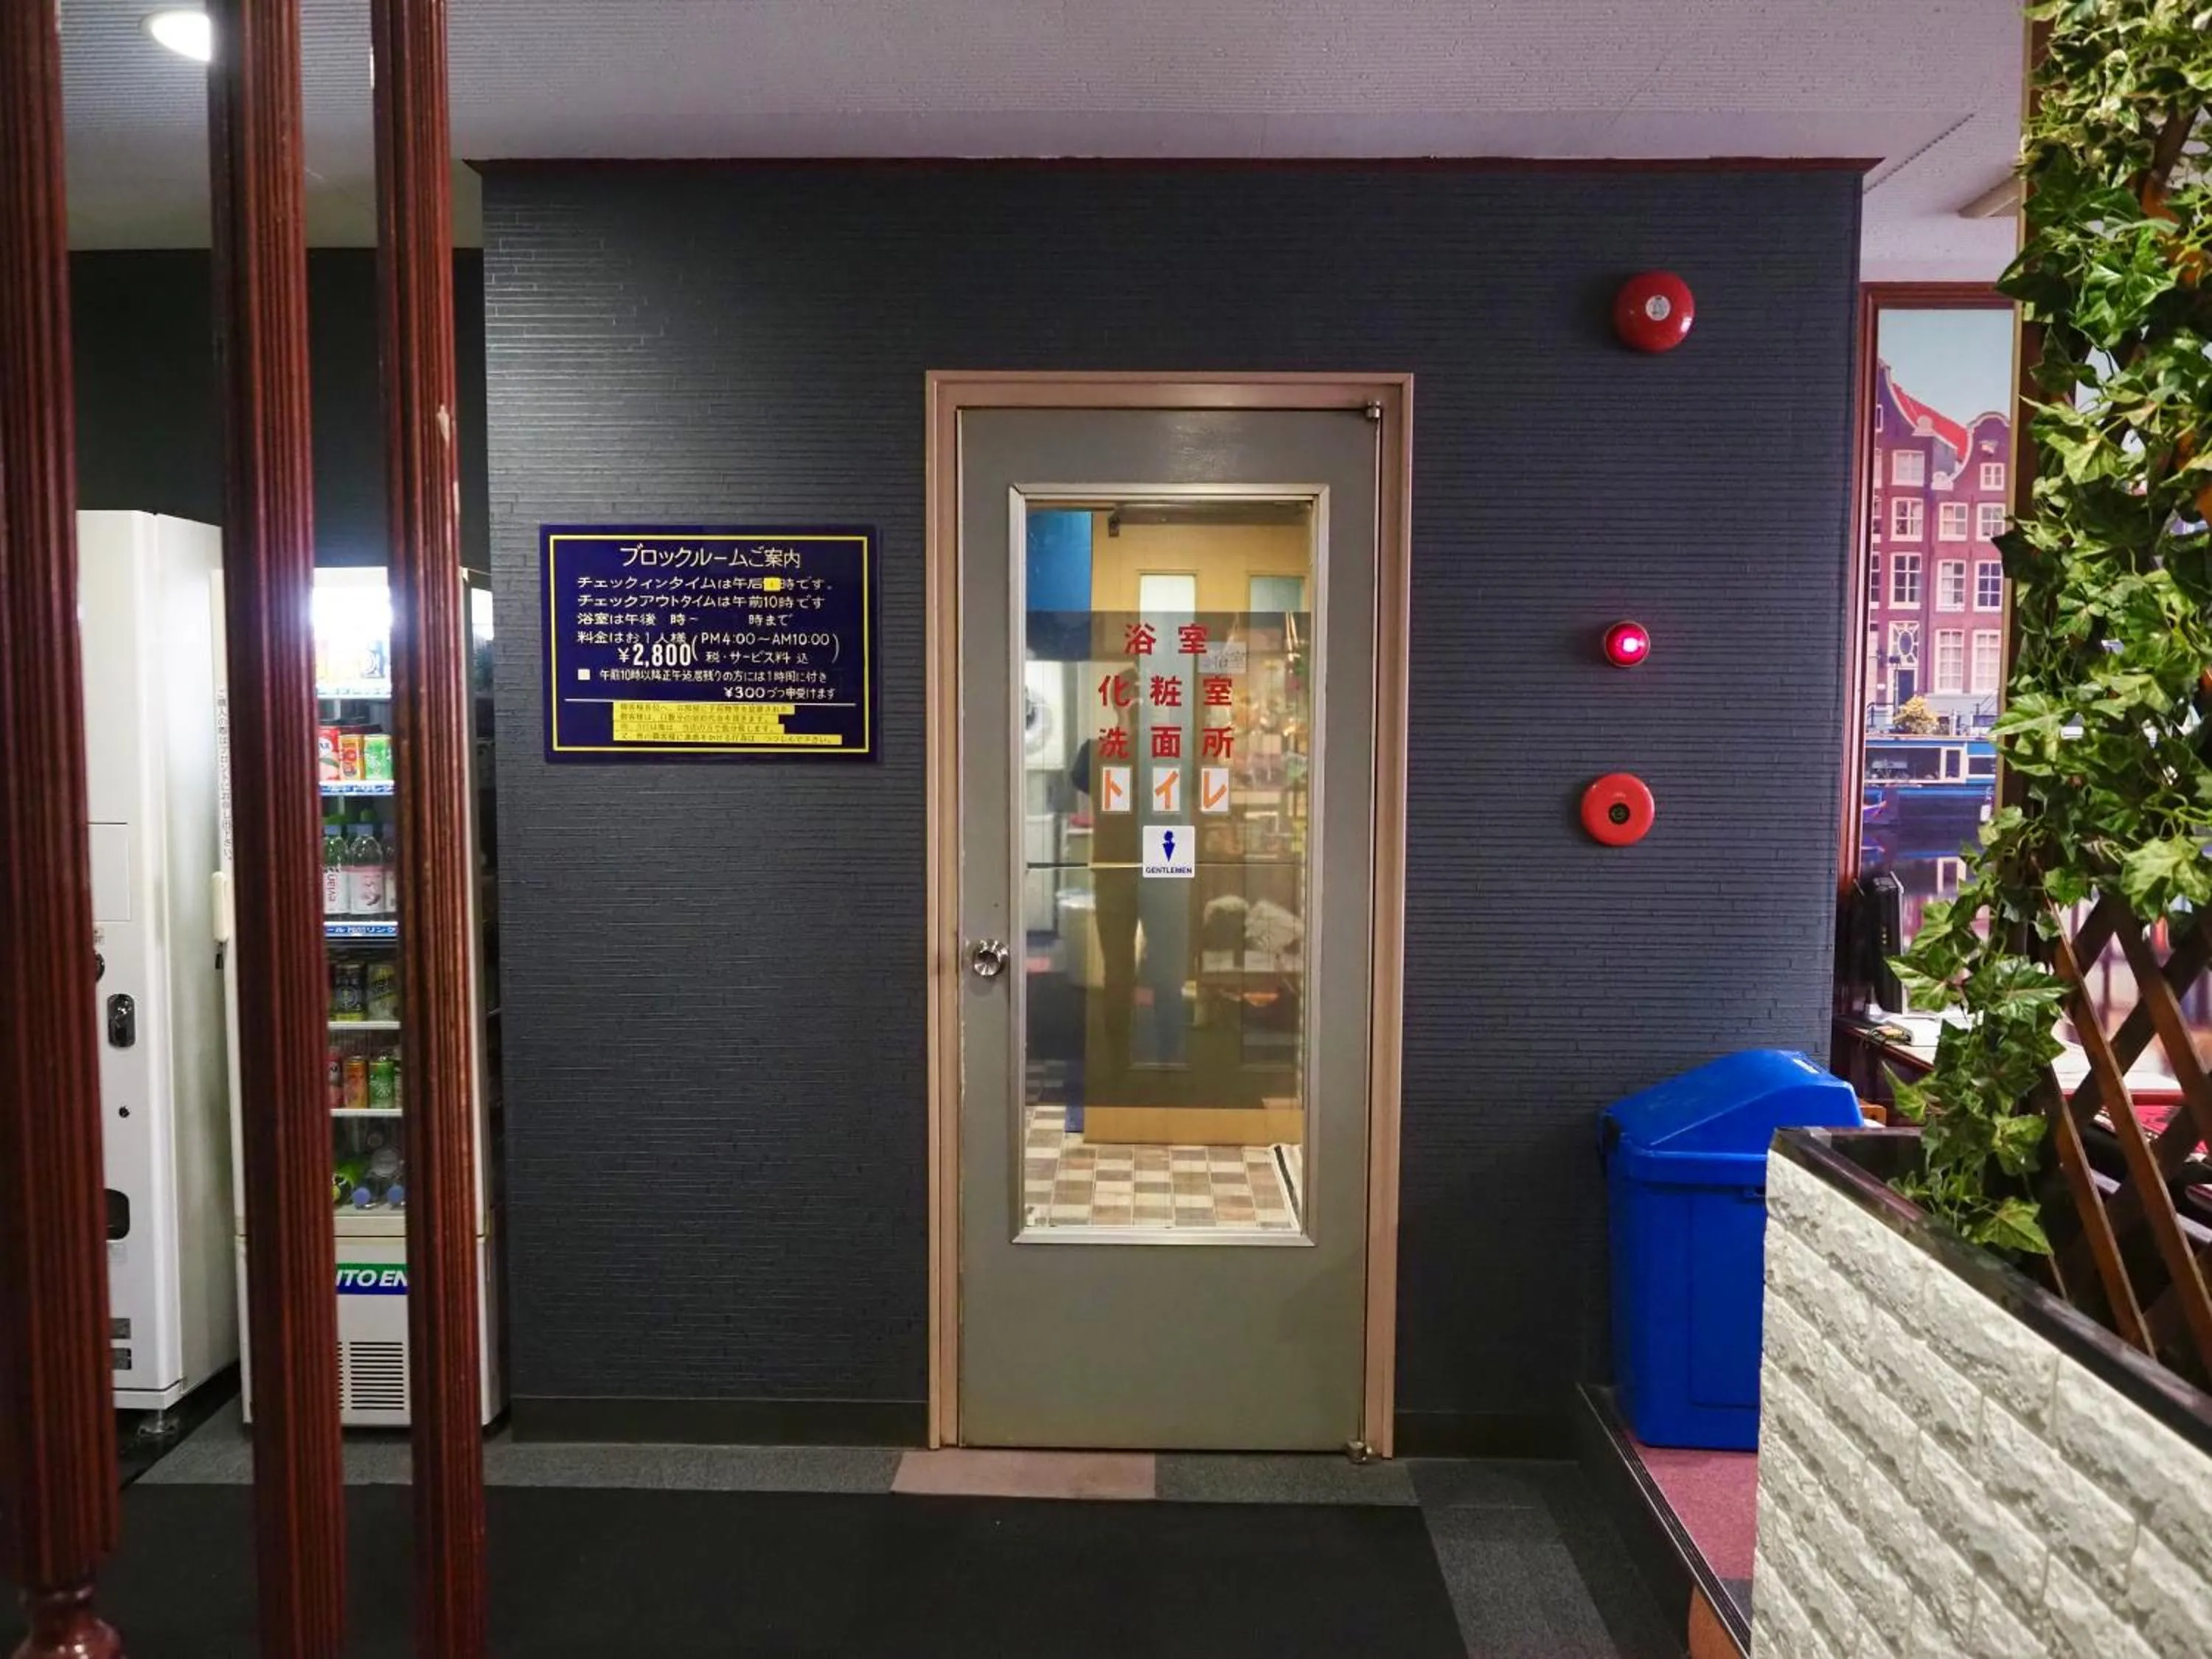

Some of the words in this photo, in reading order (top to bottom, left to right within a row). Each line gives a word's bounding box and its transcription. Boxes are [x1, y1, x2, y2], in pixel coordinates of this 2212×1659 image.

[620, 543, 801, 568] ブロックルームご案内
[617, 643, 692, 667] ¥2,800
[1125, 624, 1208, 655] 浴室
[1099, 675, 1232, 707] 化粧室
[1099, 726, 1234, 759] 洗面所
[1103, 770, 1228, 810] トイレ
